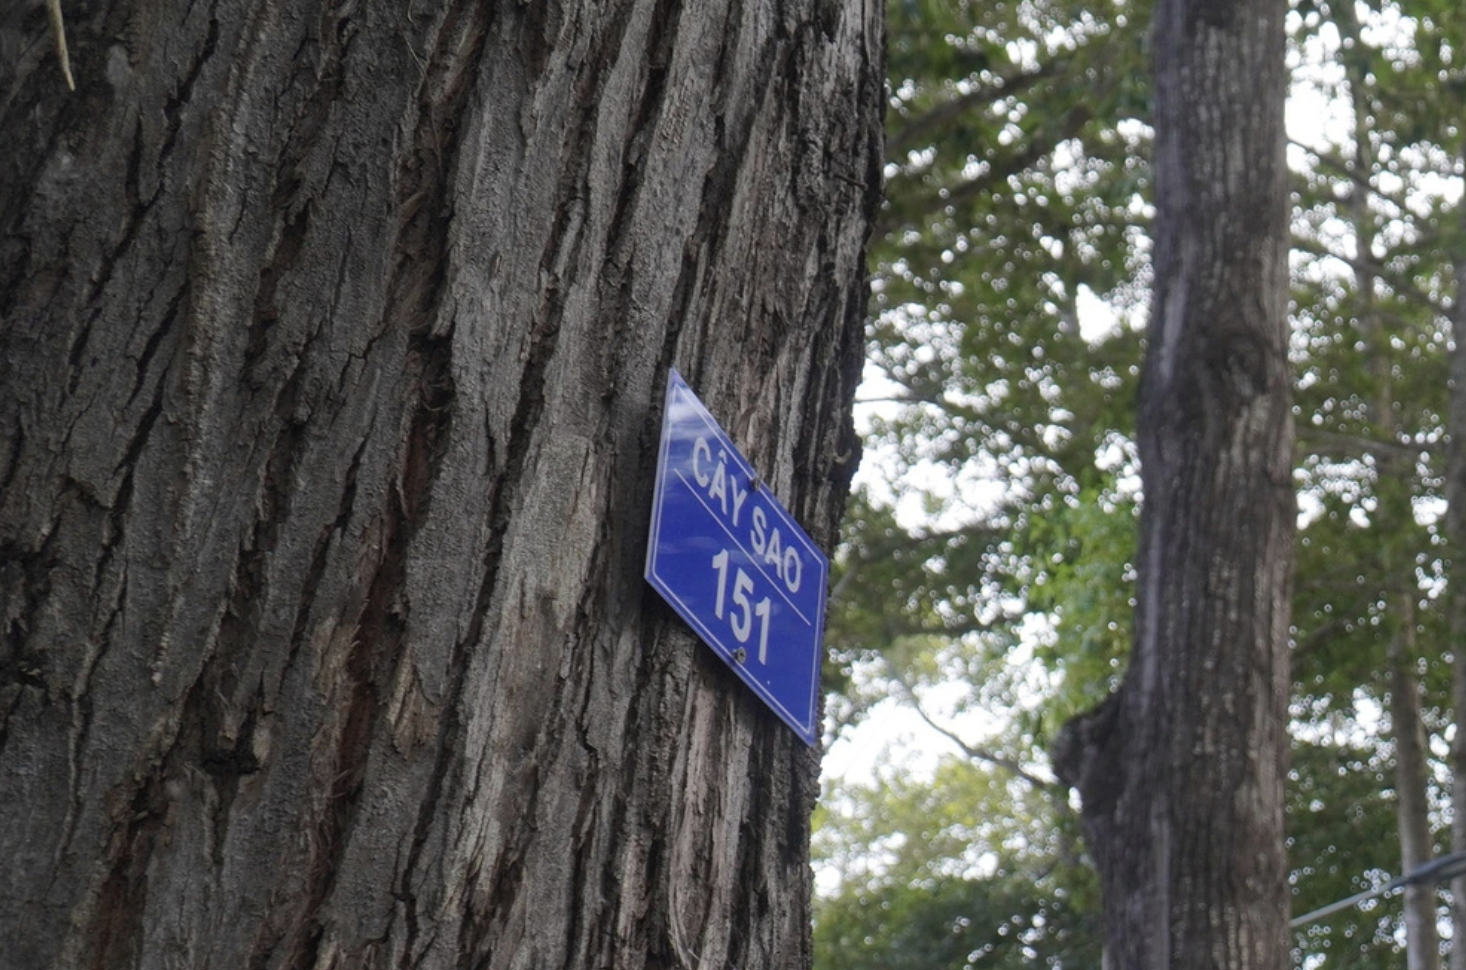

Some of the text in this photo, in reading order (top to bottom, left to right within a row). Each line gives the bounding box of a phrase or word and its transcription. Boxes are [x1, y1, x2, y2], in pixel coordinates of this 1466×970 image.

[693, 438, 802, 594] CÂY SAO
[711, 548, 771, 666] 151
